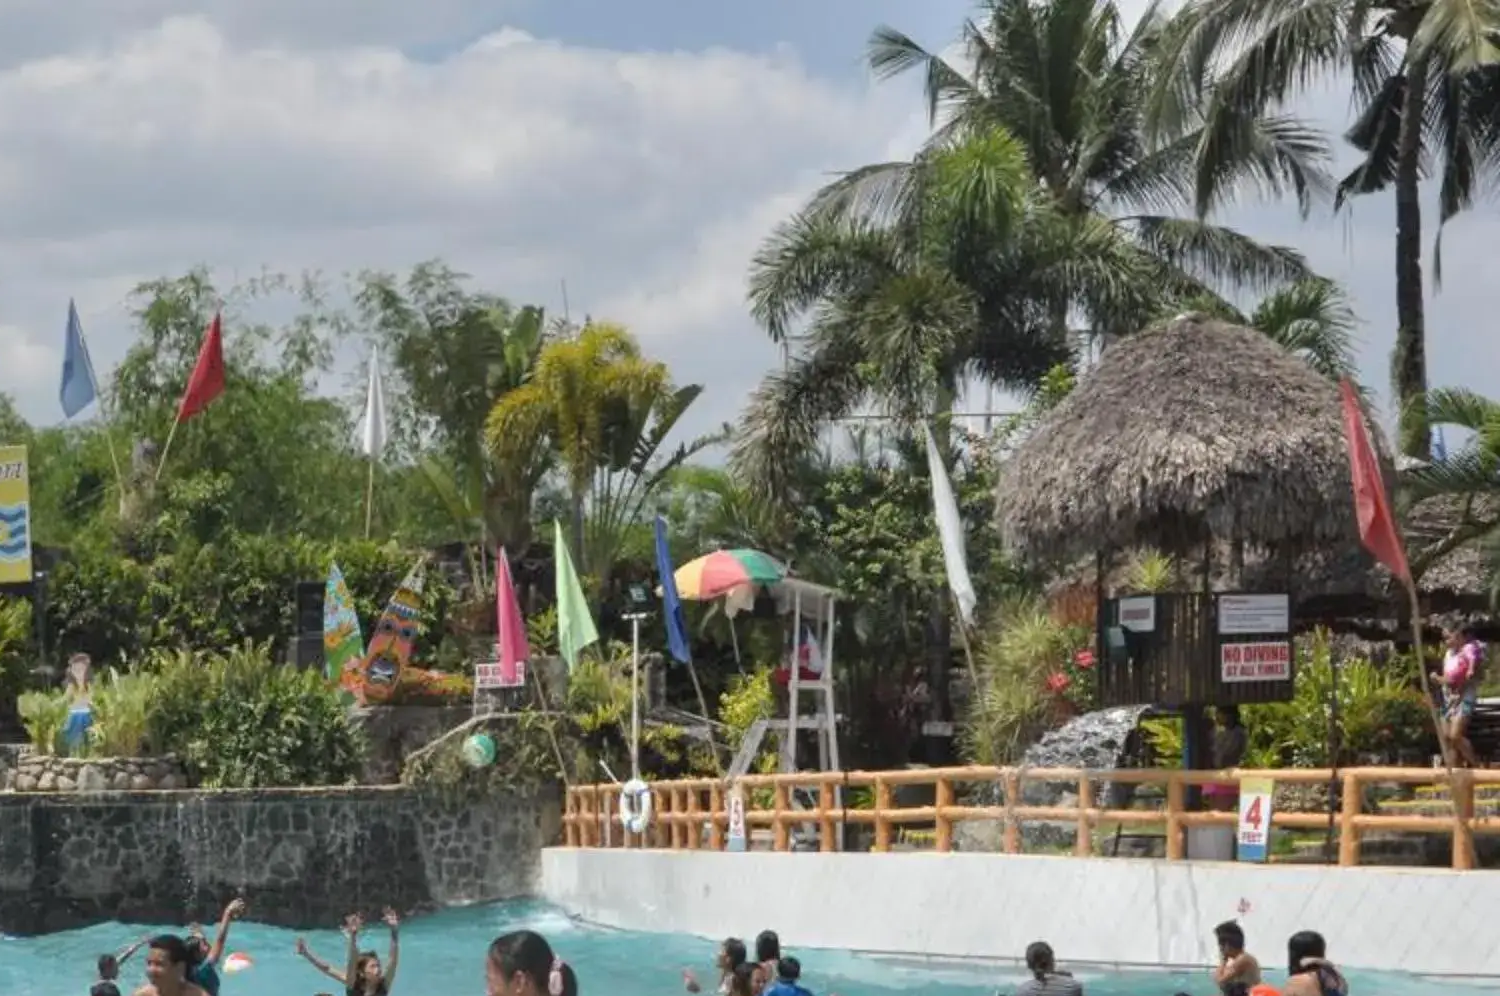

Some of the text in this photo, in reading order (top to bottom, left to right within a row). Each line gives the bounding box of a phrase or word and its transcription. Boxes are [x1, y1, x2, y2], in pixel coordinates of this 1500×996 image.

[1224, 645, 1288, 662] NO DIVING
[1245, 796, 1263, 829] 4
